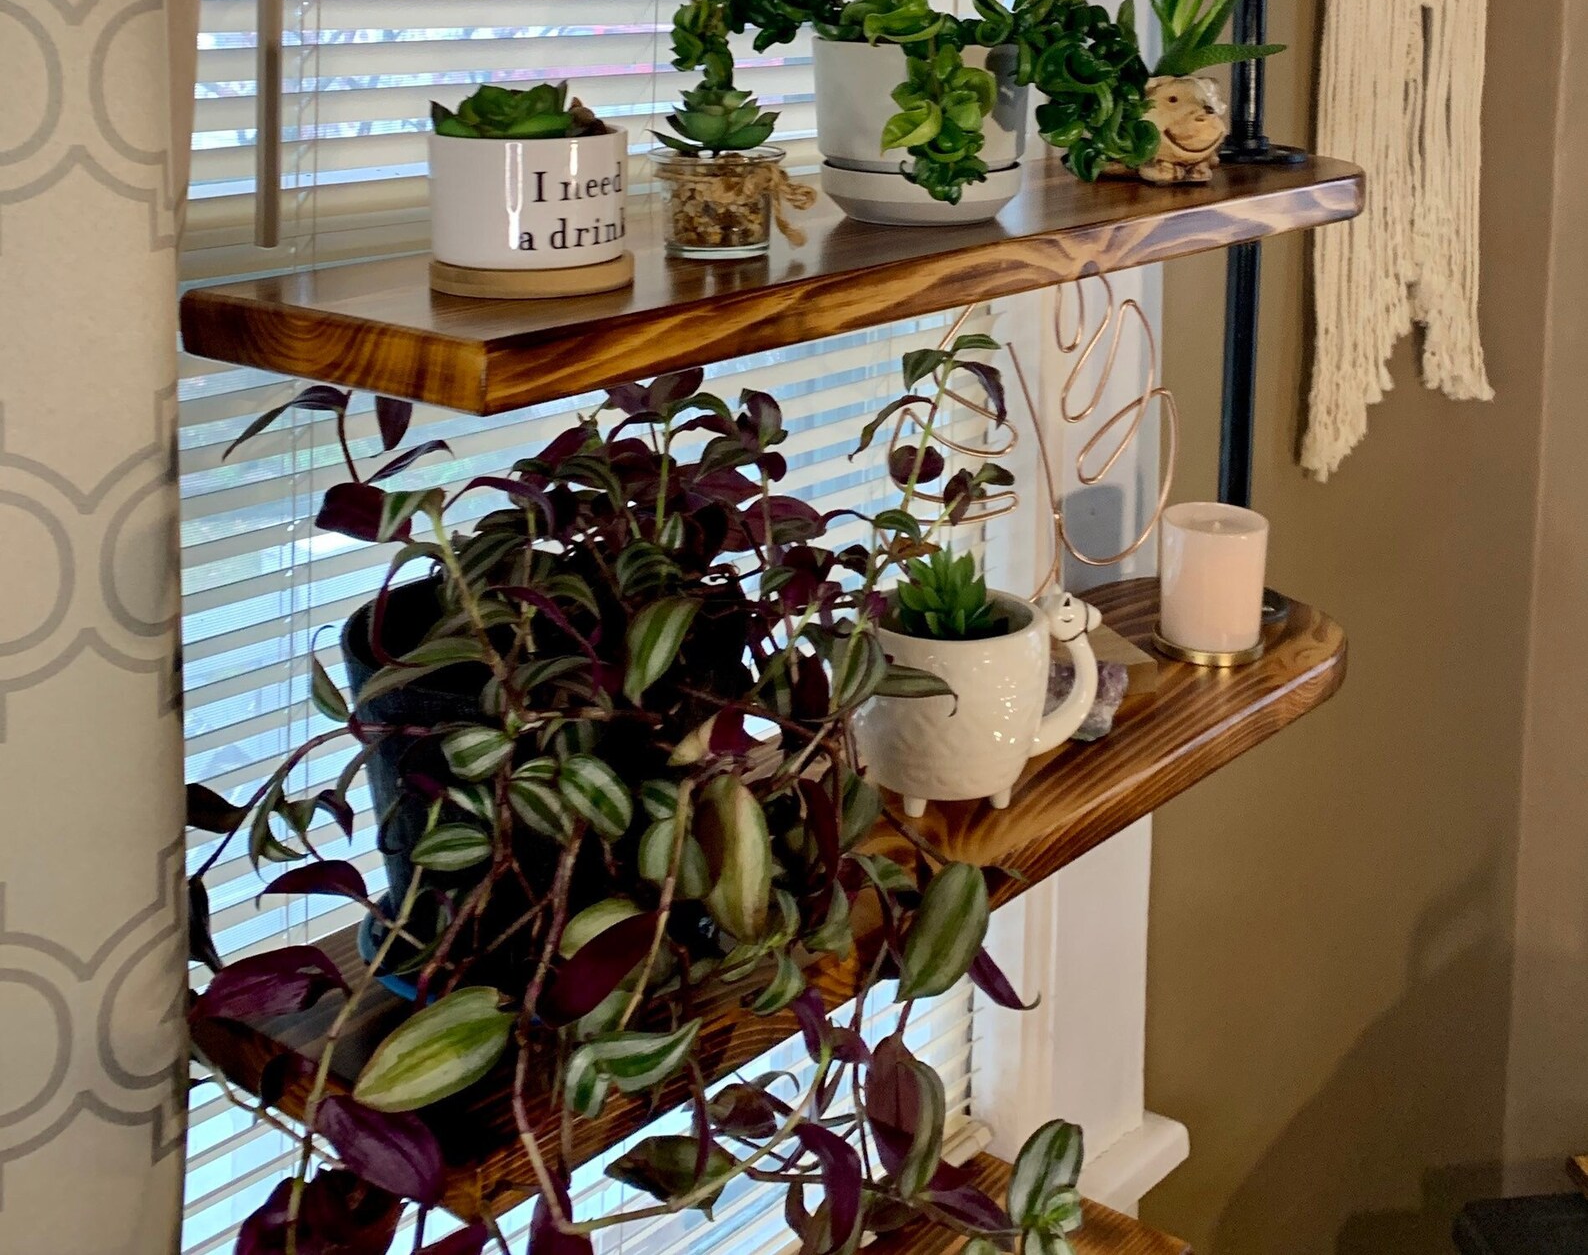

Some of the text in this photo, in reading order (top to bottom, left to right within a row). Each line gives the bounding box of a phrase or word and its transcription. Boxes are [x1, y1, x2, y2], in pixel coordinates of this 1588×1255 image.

[532, 161, 623, 203] I need
[518, 231, 538, 251] a
